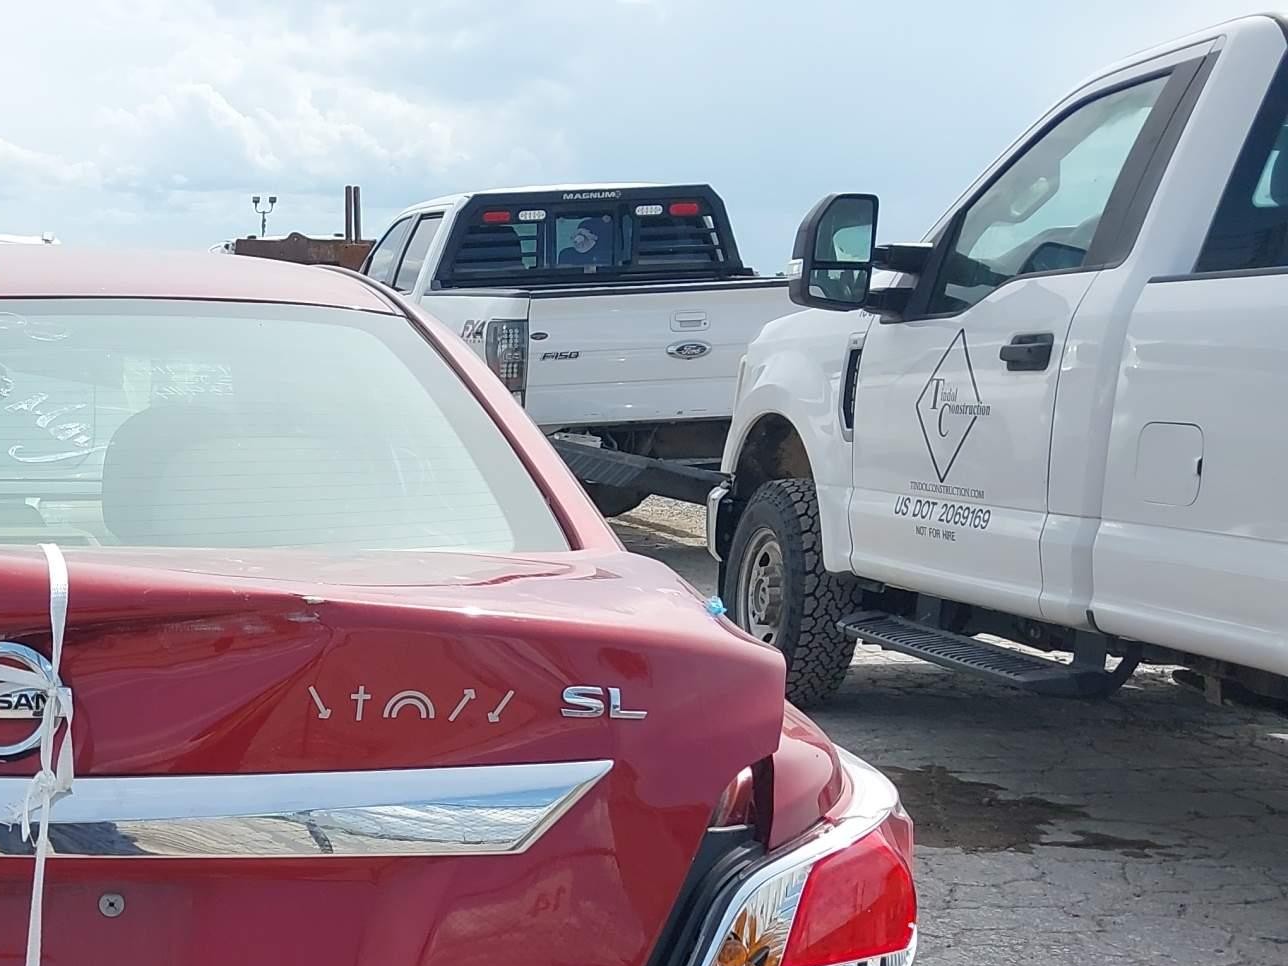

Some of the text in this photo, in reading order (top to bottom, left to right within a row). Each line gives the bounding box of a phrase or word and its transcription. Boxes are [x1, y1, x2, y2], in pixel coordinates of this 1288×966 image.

[563, 191, 616, 200] MAGNUM
[938, 402, 991, 438] Construction
[894, 496, 991, 530] US DOT 2069169
[915, 526, 956, 541] NOT FOR HIRE
[560, 685, 648, 719] SL
